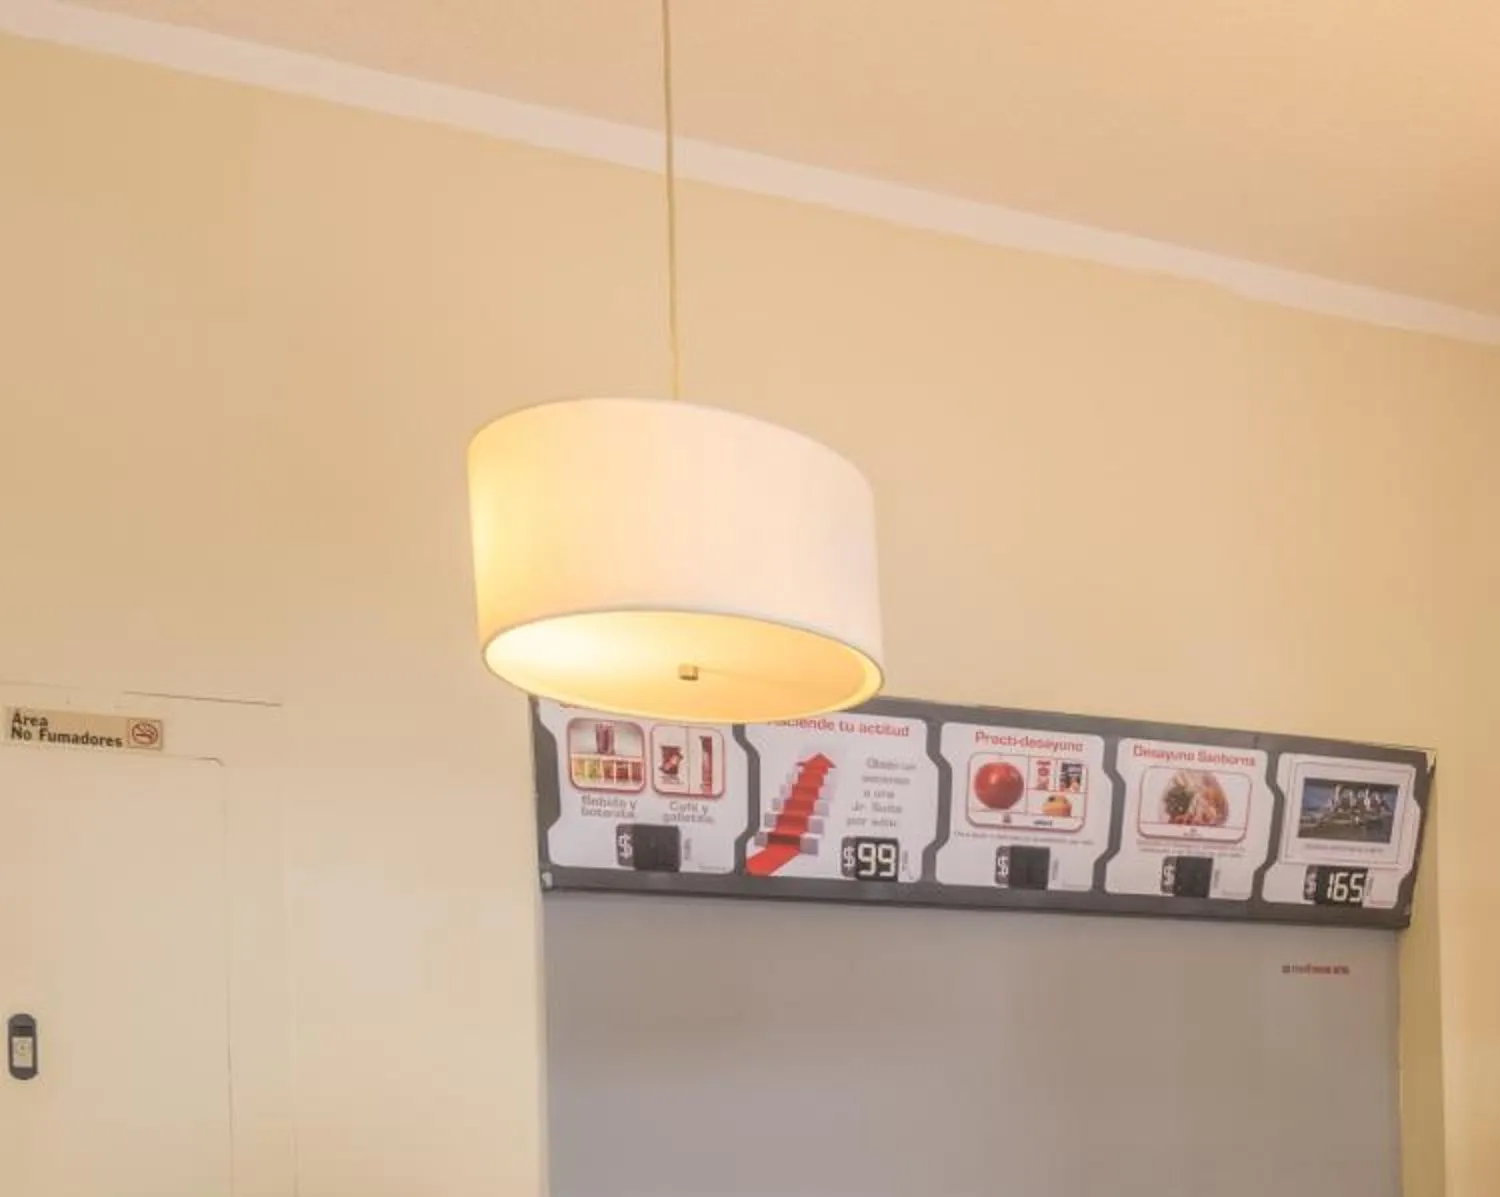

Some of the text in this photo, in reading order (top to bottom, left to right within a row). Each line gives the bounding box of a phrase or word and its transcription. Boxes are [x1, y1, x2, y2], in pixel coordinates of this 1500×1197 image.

[10, 726, 123, 749] No Fumadores
[838, 719, 855, 733] tu
[859, 720, 909, 738] actitud
[1327, 871, 1365, 903] 165
